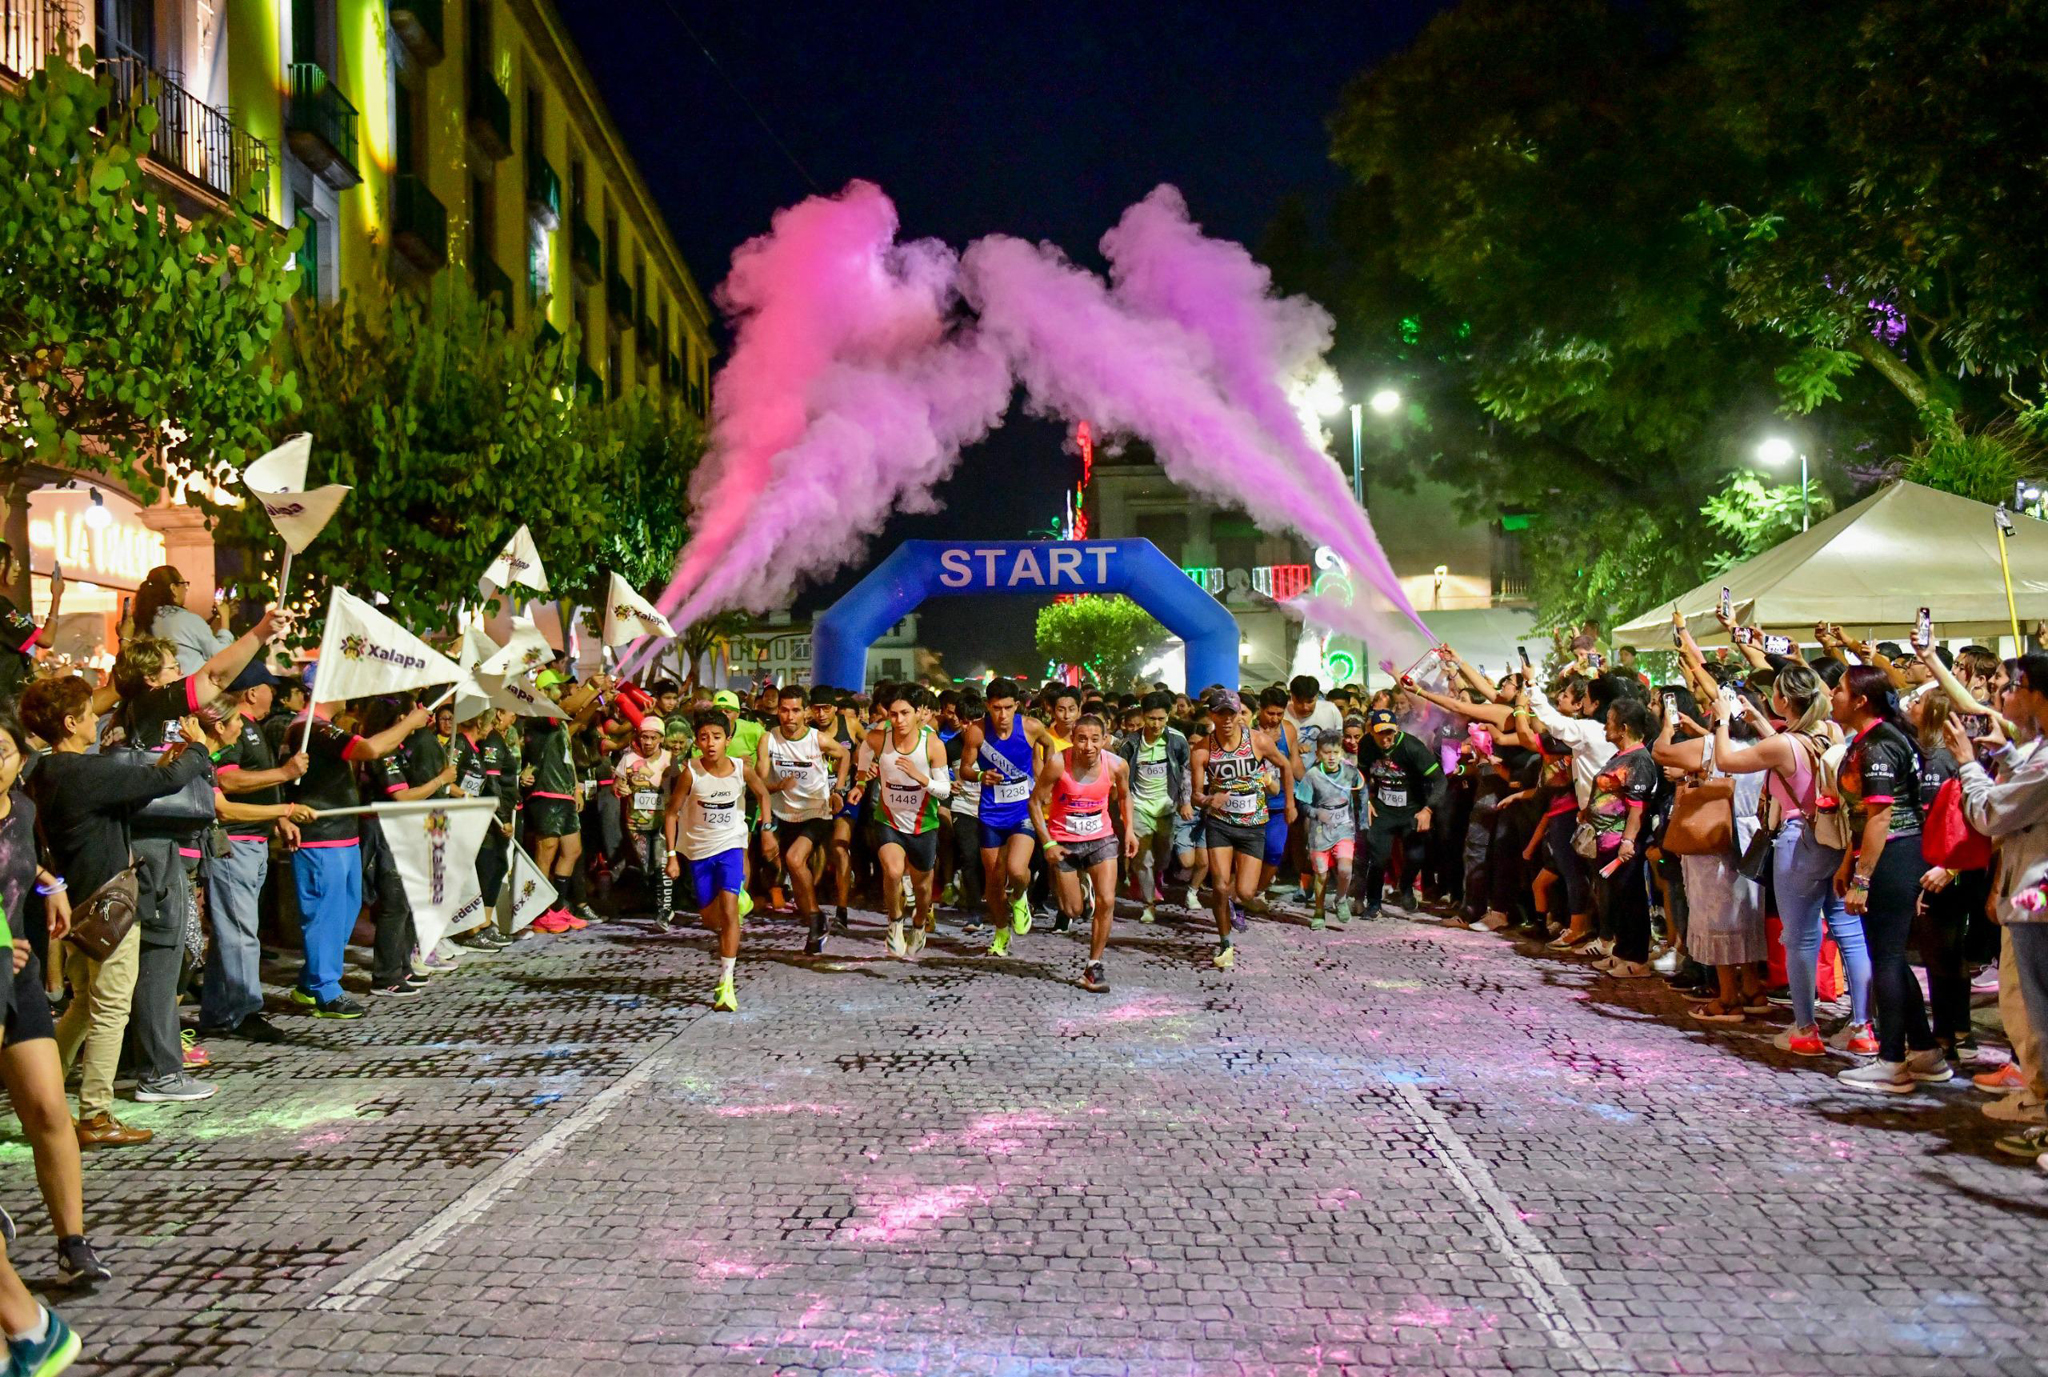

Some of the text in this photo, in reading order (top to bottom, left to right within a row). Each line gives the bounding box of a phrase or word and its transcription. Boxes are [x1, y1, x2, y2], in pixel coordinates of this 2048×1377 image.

[939, 547, 1117, 588] START
[367, 643, 426, 669] Xalapa
[1000, 785, 1026, 799] 1238
[889, 793, 918, 805] 1448
[1225, 798, 1252, 809] 0681
[1381, 793, 1404, 804] 0786
[702, 812, 732, 824] 1235
